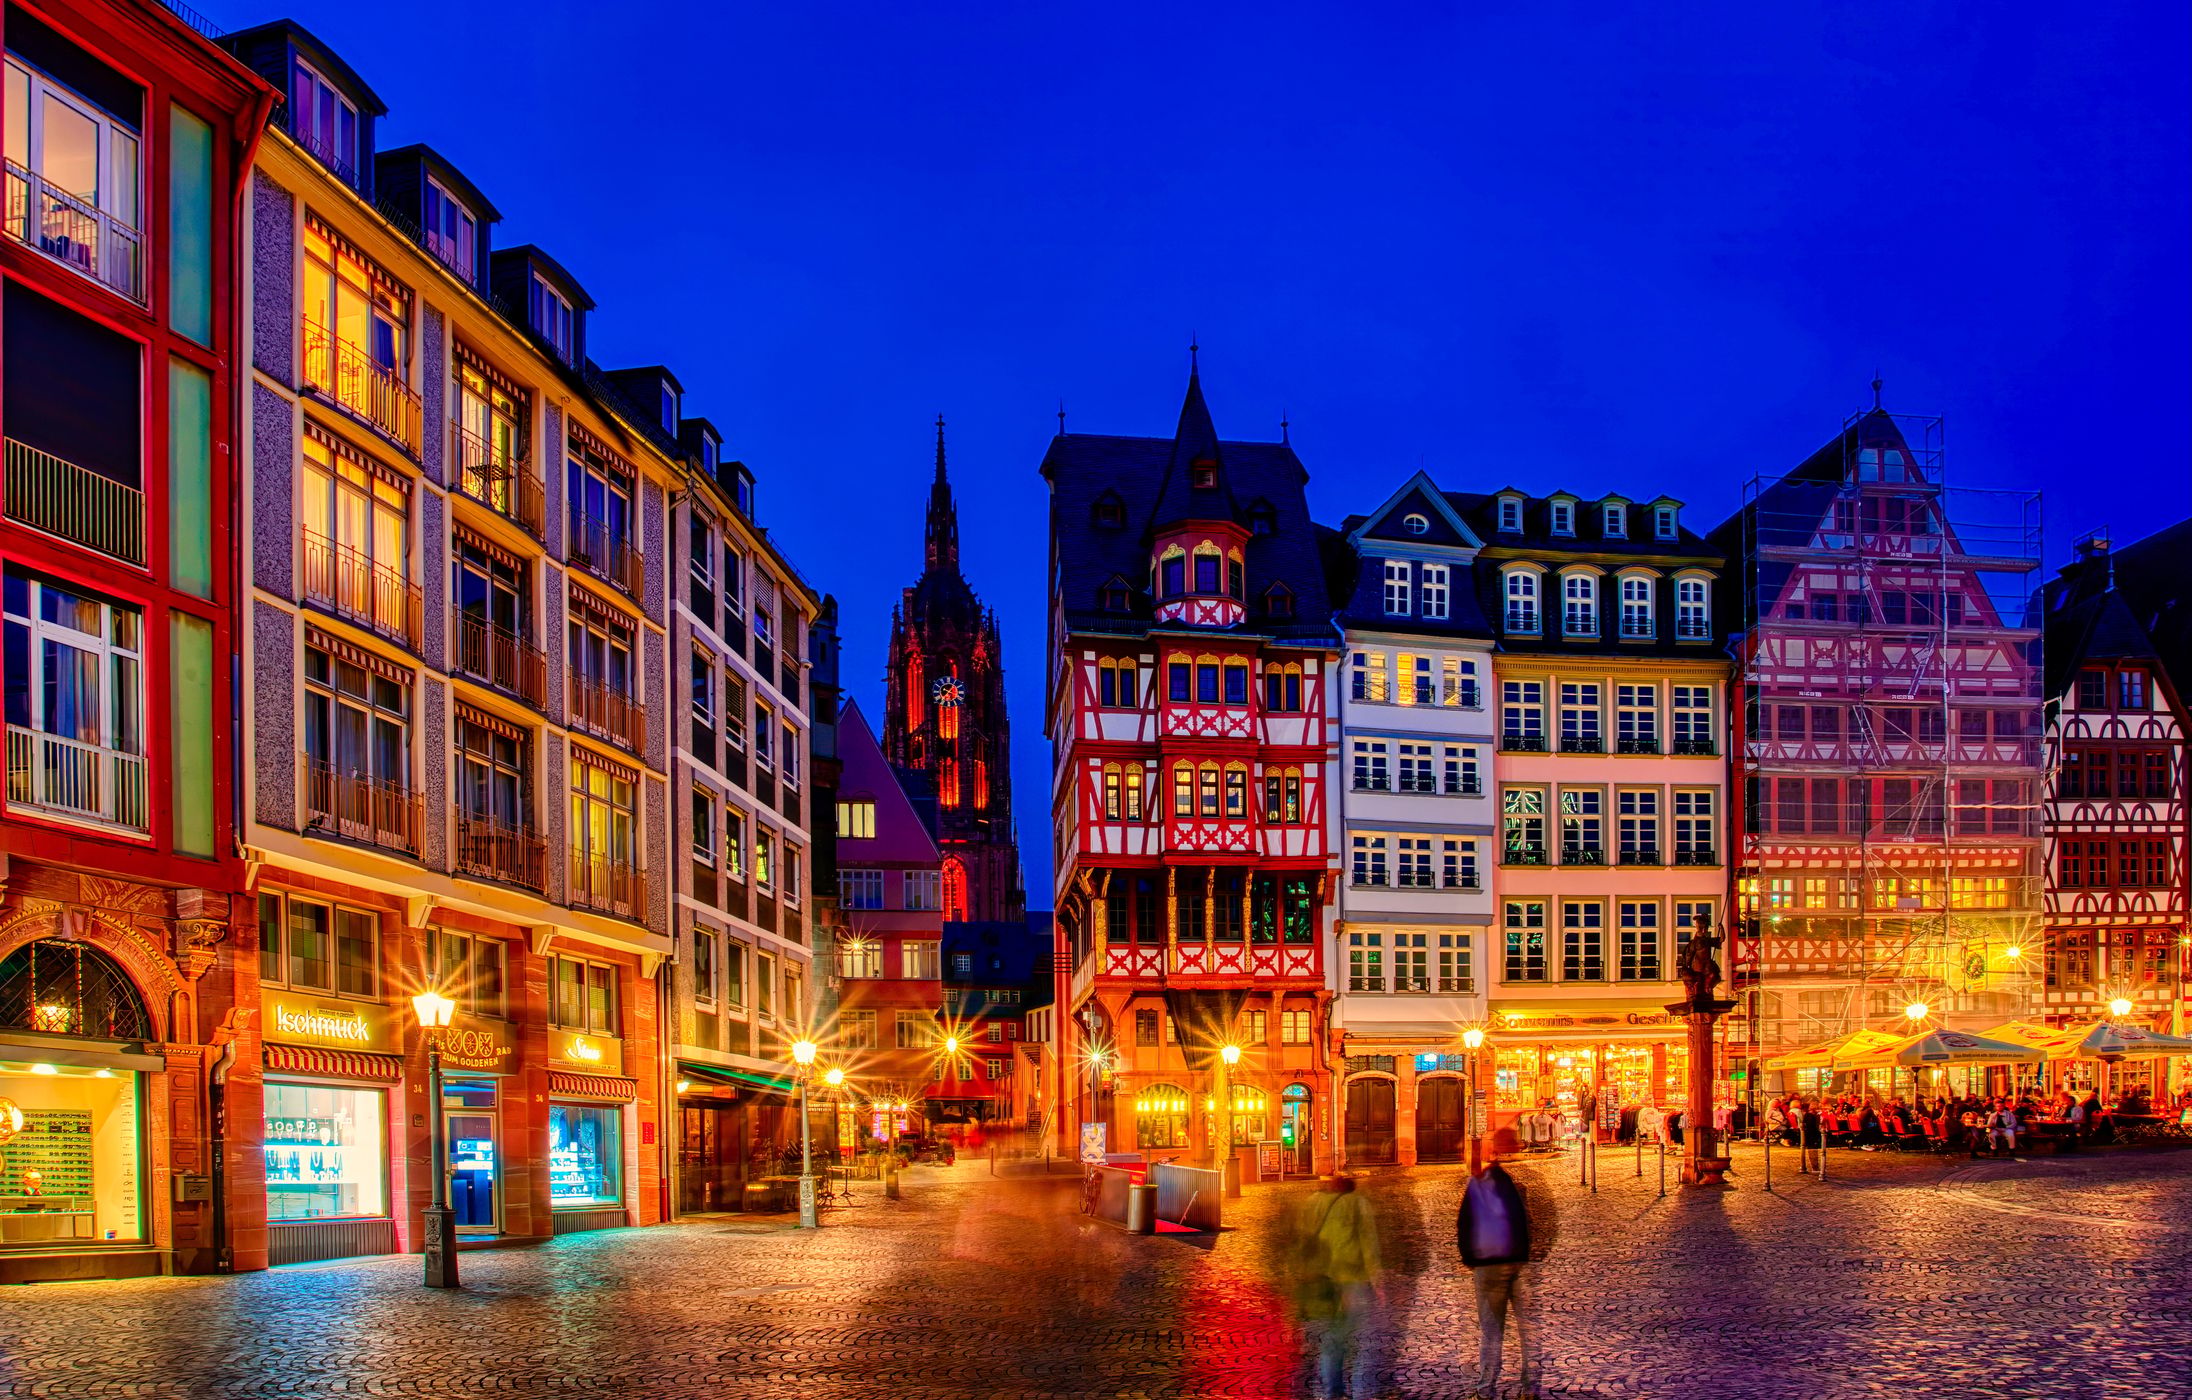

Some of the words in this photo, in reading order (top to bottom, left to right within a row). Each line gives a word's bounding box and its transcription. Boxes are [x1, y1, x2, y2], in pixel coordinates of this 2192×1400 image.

[442, 1051, 459, 1064] ZUM
[460, 1057, 499, 1067] GOLDENEN
[496, 1046, 512, 1056] RAD
[413, 1084, 423, 1093] 34
